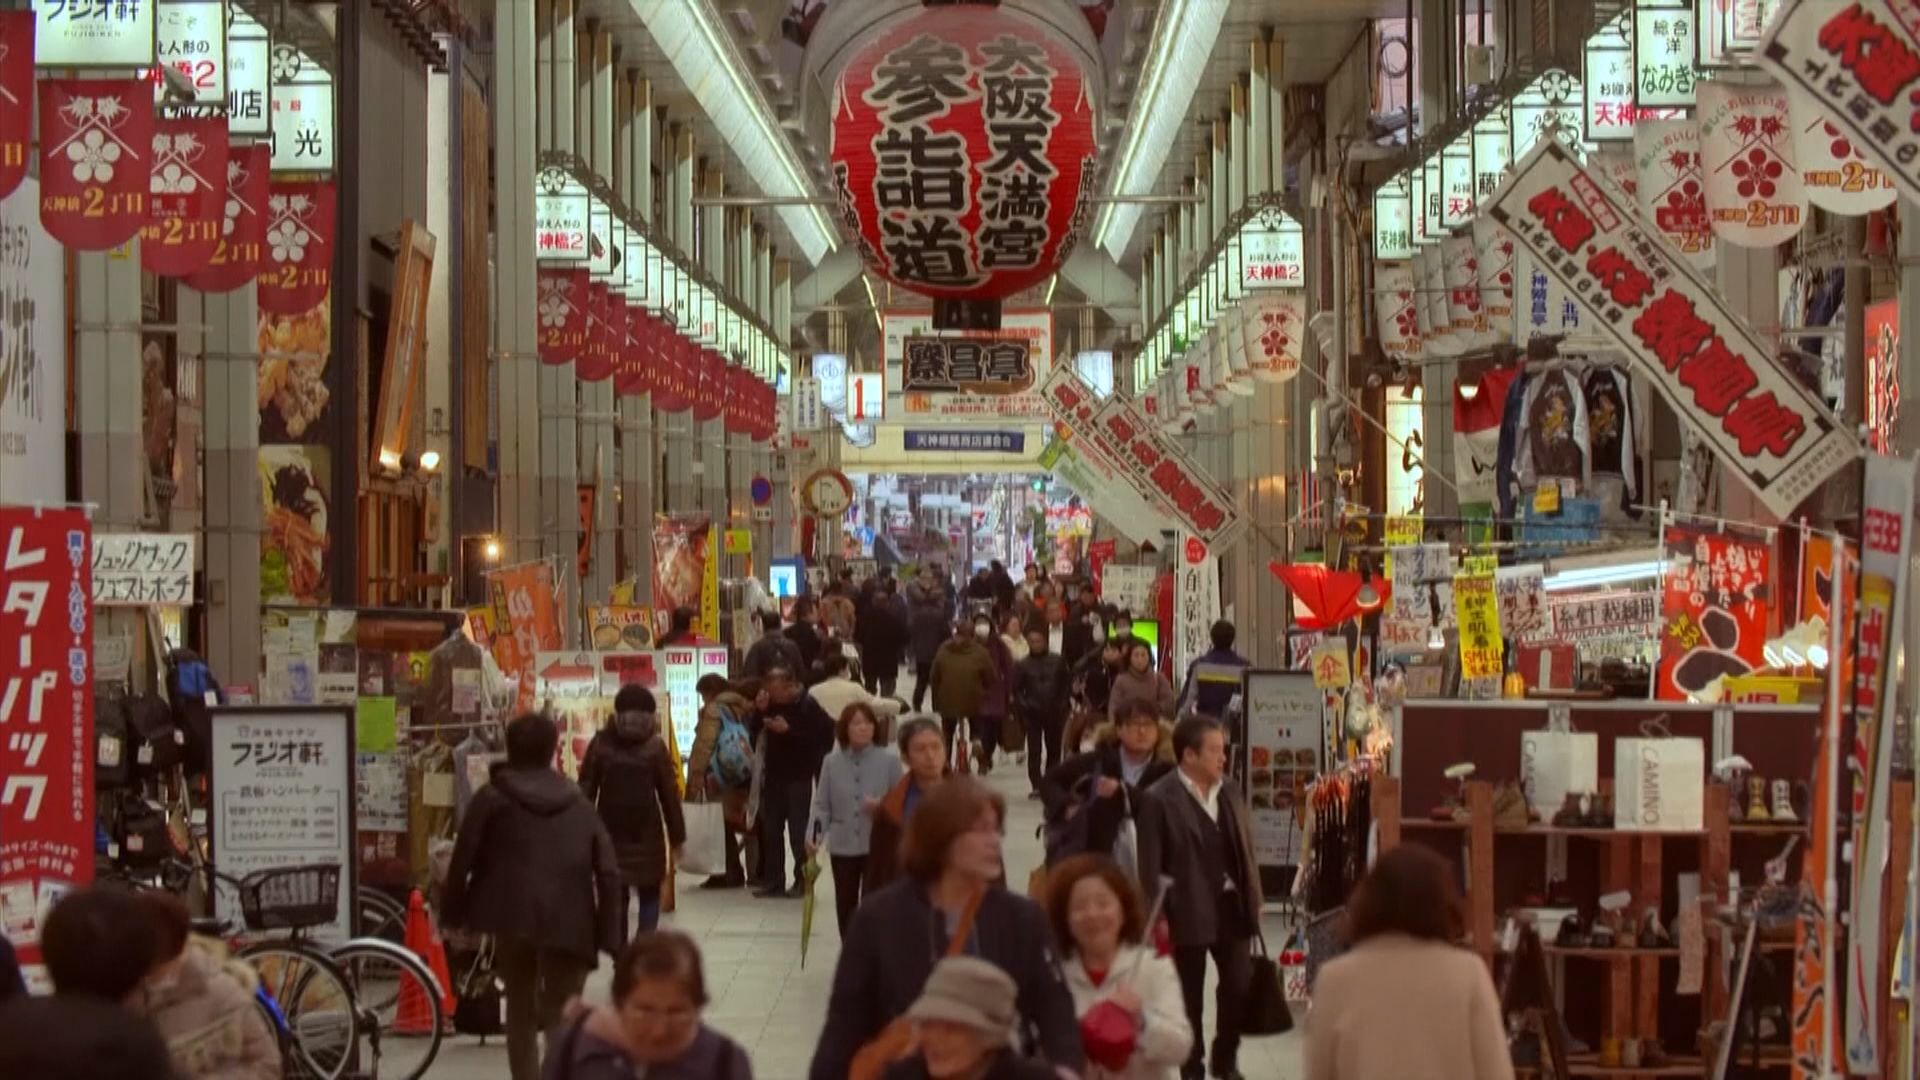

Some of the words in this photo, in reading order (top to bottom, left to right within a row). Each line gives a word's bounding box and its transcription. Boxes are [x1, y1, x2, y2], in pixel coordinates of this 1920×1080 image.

[869, 38, 985, 284] 参詣道
[979, 38, 1056, 267] 大阪天満宮
[42, 186, 143, 218] 天神橋2丁目
[1246, 264, 1300, 281] 天神橋2
[854, 378, 864, 421] 1
[0, 527, 57, 820] レターパック
[230, 739, 323, 767] フジオ軒
[1642, 745, 1661, 826] CAMINO
